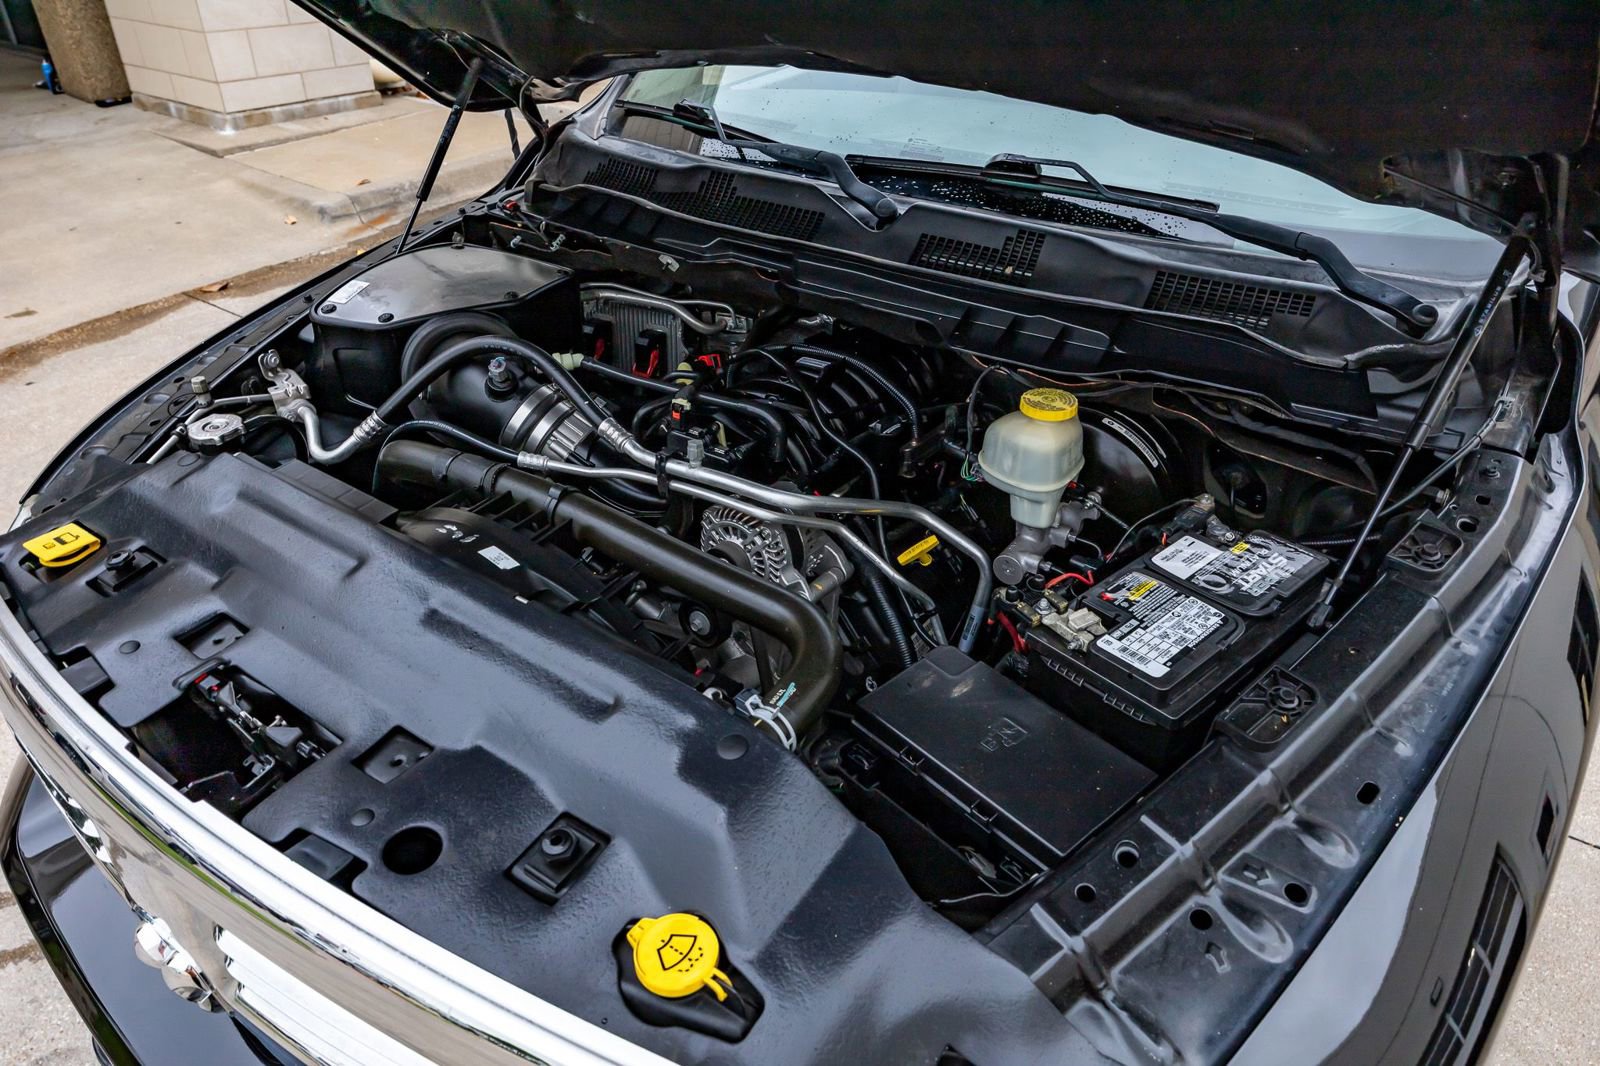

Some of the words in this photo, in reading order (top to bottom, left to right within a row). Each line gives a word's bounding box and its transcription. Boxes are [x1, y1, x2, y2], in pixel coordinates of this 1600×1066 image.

[1230, 549, 1268, 577] PLATINUM
[1239, 552, 1287, 592] START
[1247, 563, 1296, 596] SUPER
